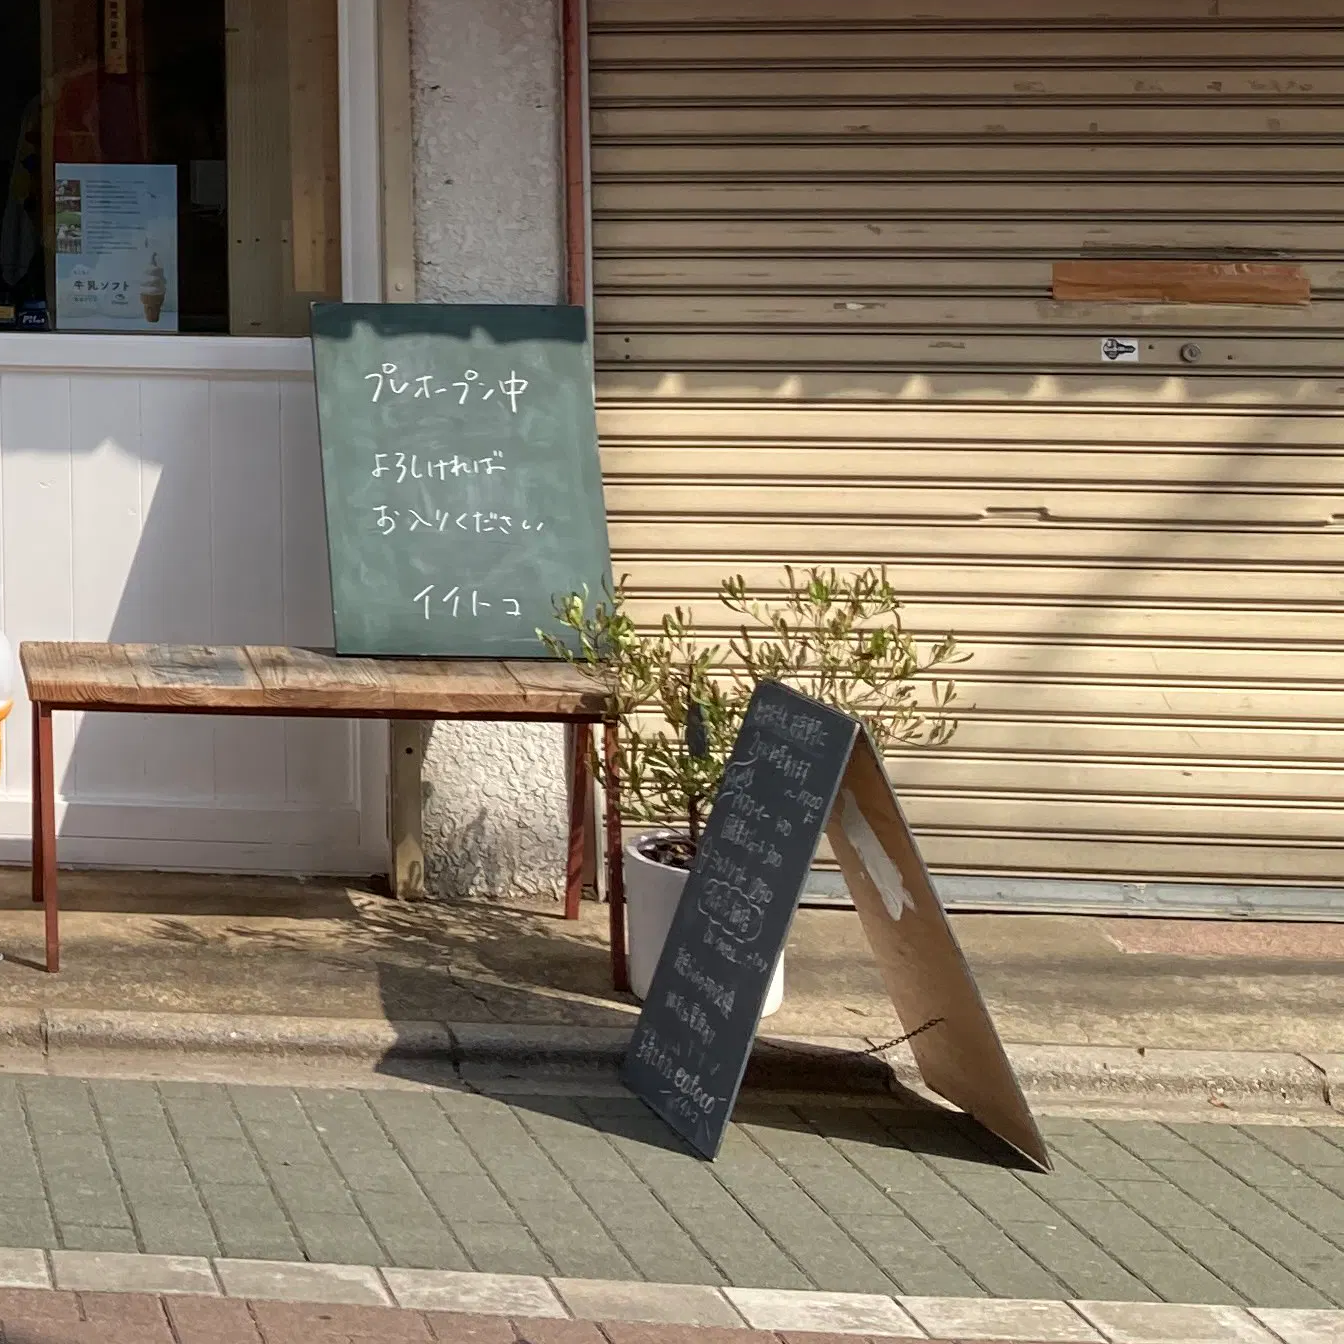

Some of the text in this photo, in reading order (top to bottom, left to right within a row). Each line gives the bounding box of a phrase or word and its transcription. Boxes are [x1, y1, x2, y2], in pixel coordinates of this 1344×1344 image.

[73, 280, 130, 291] 牛乳ソフト
[365, 363, 528, 414] プレオープン中
[372, 450, 506, 484] よろしければ
[373, 505, 544, 535] お入りください
[413, 584, 522, 620] イイトコ
